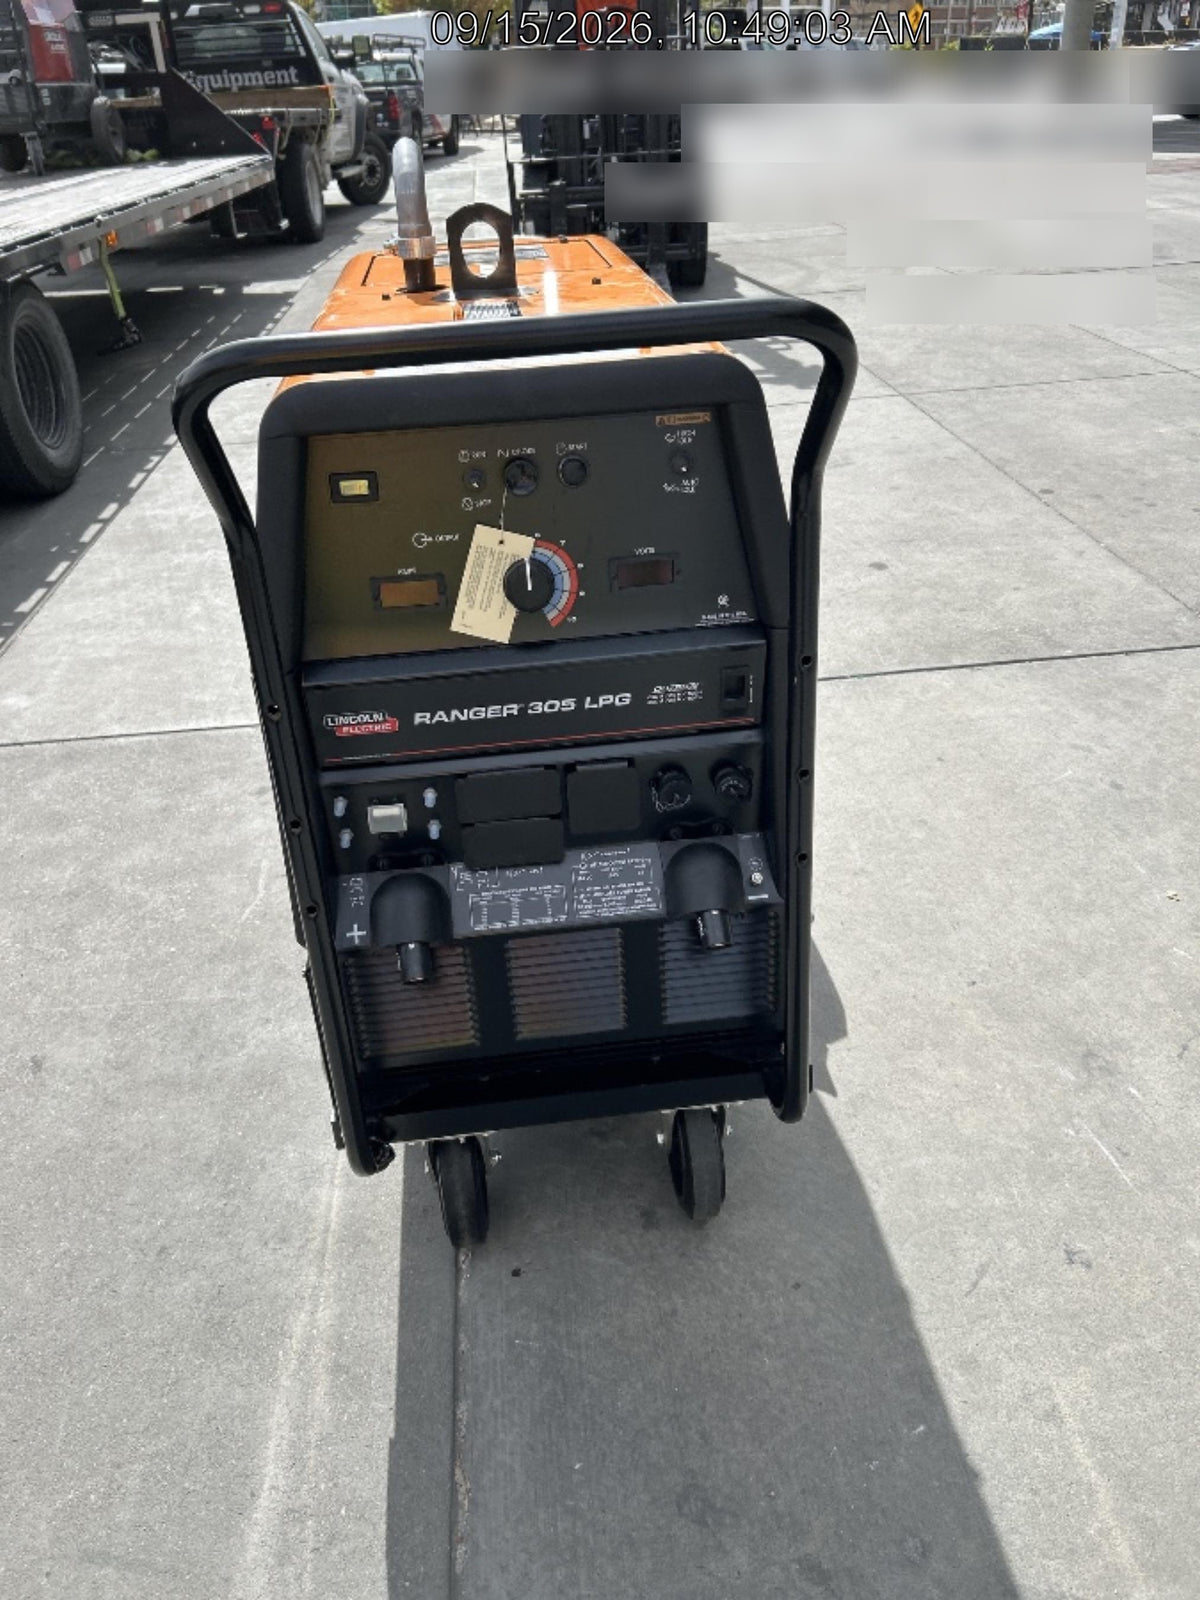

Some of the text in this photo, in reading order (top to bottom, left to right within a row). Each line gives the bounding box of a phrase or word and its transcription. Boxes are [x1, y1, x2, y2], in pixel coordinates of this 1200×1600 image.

[326, 711, 385, 727] LINCOLN
[413, 703, 520, 726] RANGER
[527, 698, 577, 715] 305
[584, 692, 632, 709] LPG
